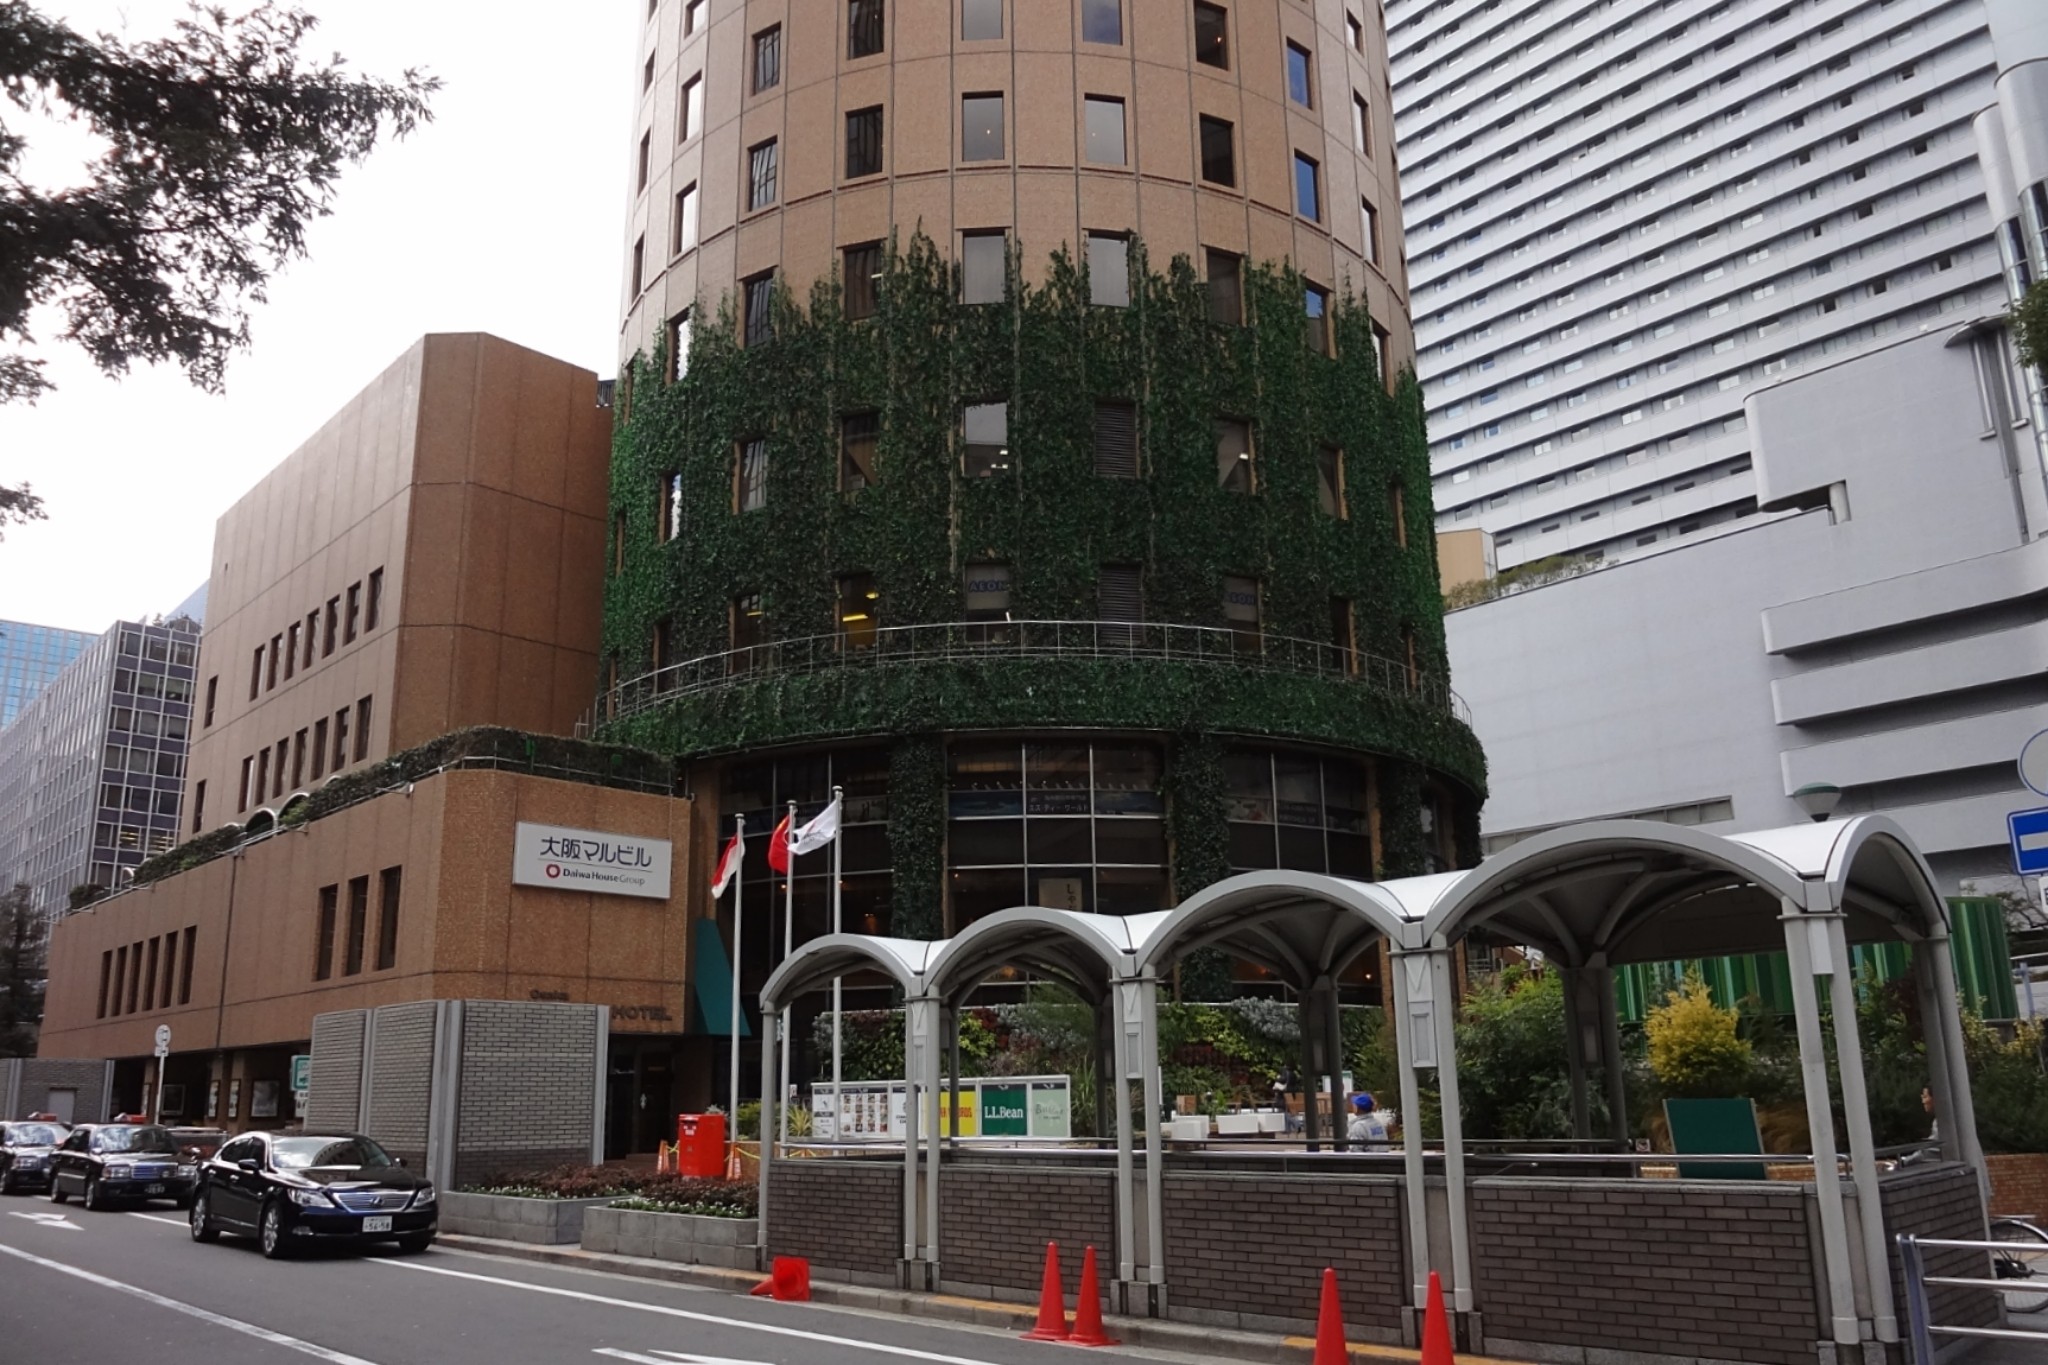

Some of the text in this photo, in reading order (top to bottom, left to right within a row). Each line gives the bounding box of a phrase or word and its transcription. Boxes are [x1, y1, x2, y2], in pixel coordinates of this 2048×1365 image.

[540, 836, 652, 867] 大阪マルビル
[563, 868, 646, 887] Daiwa House Group
[611, 1006, 673, 1021] HOTEL
[984, 1105, 1024, 1119] L.L.Bean
